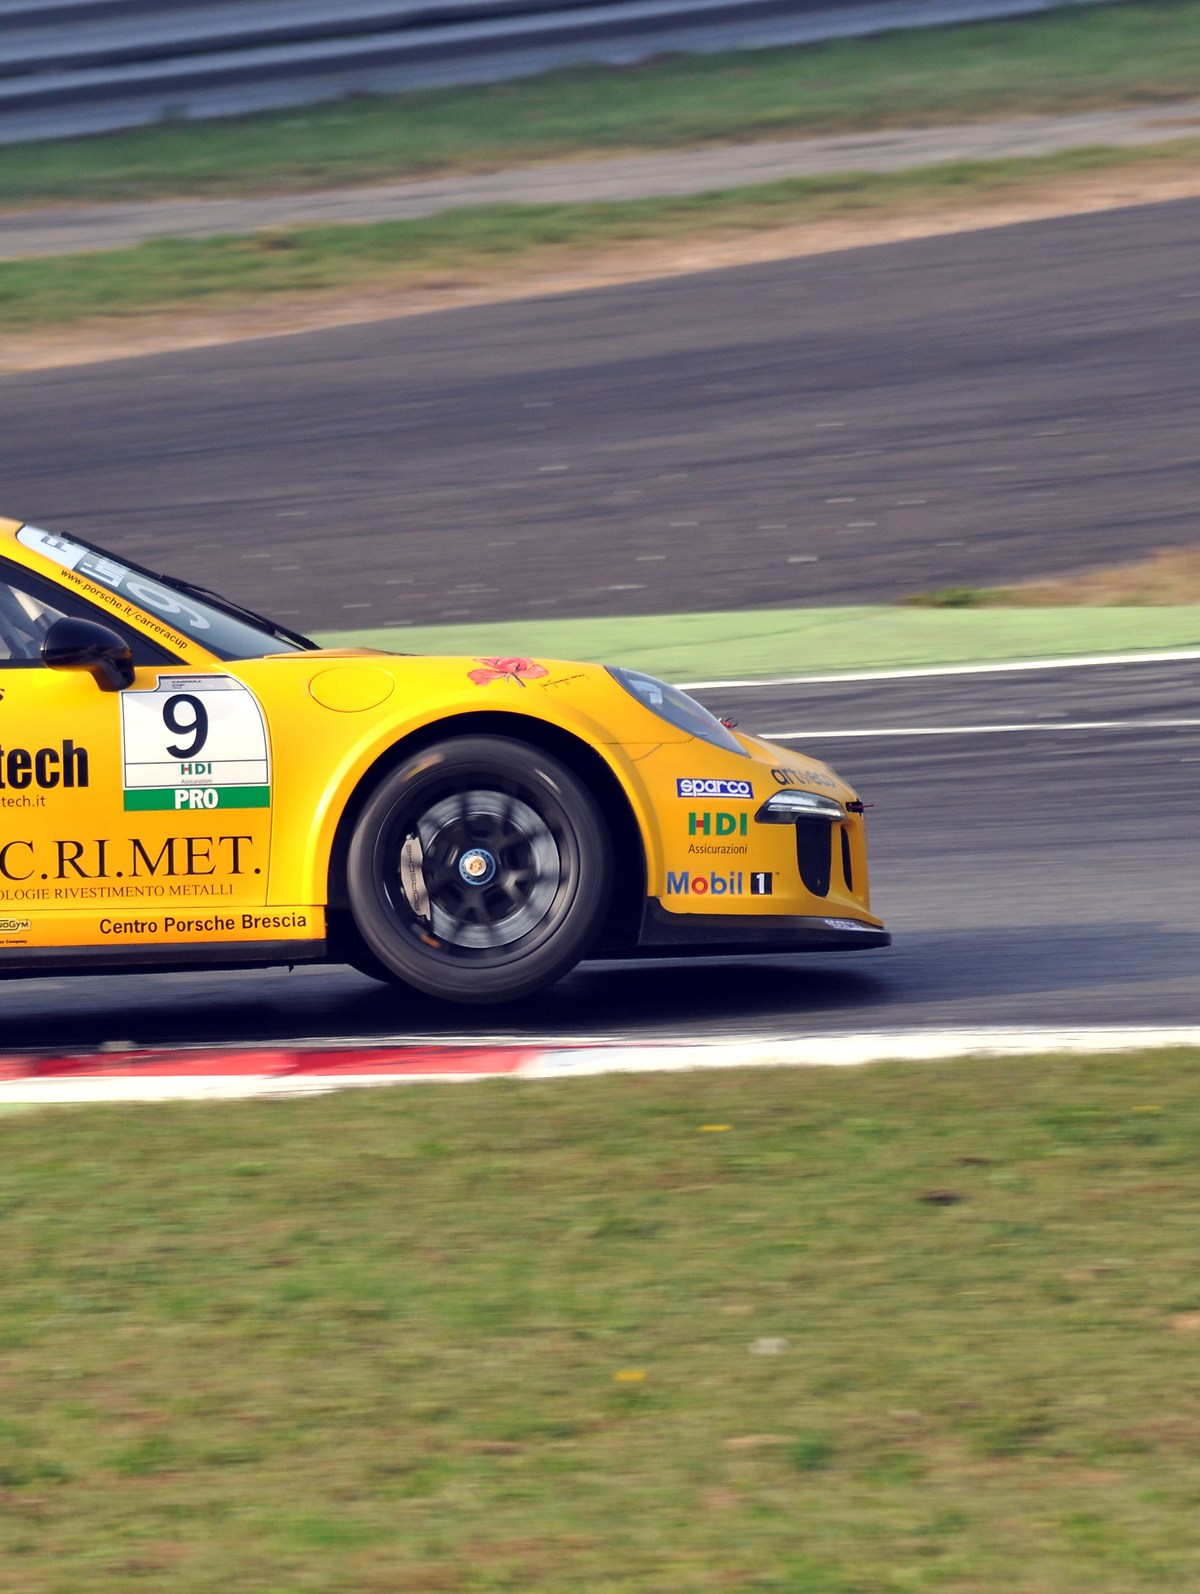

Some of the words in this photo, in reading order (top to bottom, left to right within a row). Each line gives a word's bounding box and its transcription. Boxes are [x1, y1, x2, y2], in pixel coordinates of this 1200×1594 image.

[60, 569, 188, 650] www.porsche.it/carreracup
[163, 693, 208, 759] 9
[181, 763, 212, 775] HDI
[680, 779, 750, 796] sparco
[174, 788, 219, 810] PRO
[688, 812, 747, 836] HDI
[688, 844, 747, 854] Assicurazioni
[54, 885, 165, 900] RIVESTIMENTO
[169, 884, 234, 897] METALLI
[667, 871, 743, 895] Mobil
[99, 919, 158, 935] Centro
[164, 916, 235, 932] Porsche
[242, 912, 307, 929] Brescia
